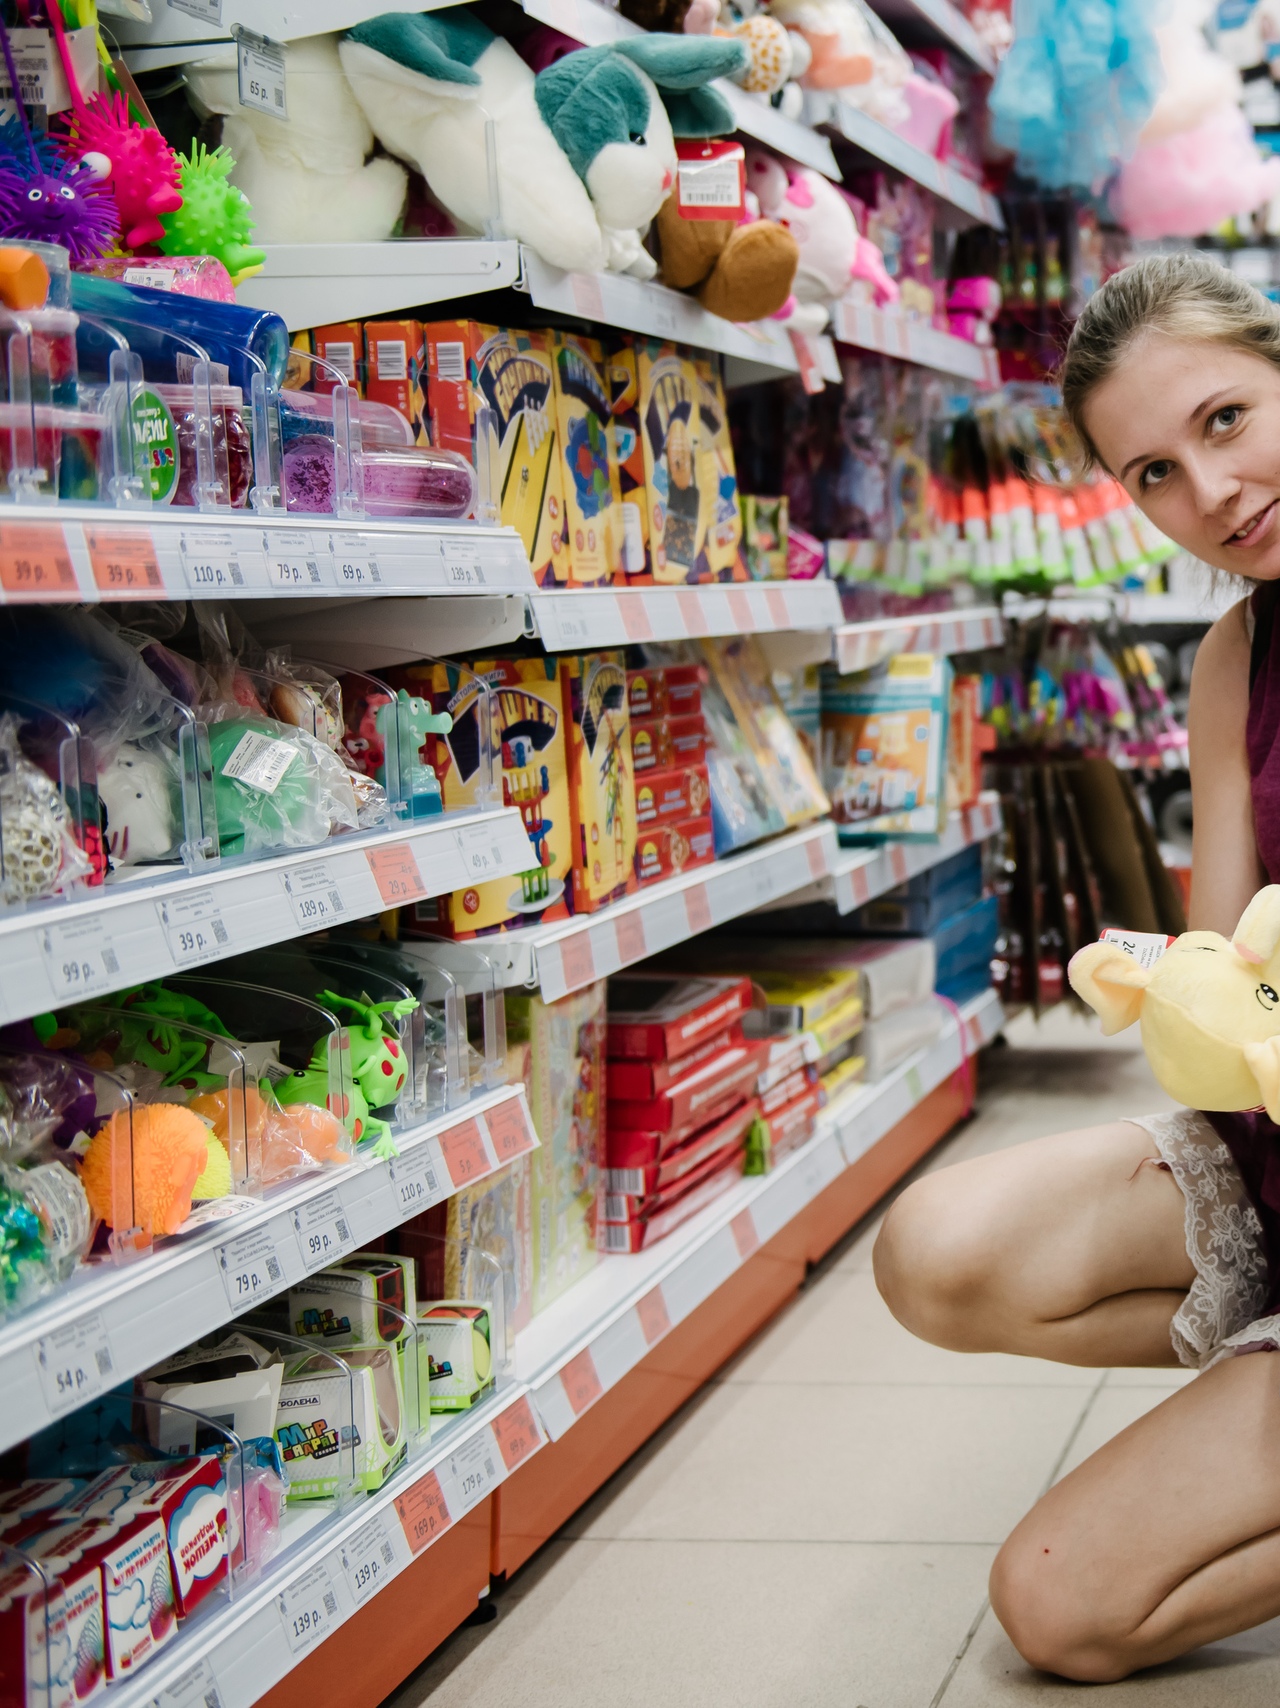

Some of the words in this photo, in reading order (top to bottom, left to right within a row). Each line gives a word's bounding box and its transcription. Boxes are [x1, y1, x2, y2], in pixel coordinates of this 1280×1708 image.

[250, 80, 259, 96] 65
[14, 559, 31, 580] 39
[107, 563, 123, 582] 39
[193, 565, 214, 582] 110
[277, 563, 291, 579] 79
[342, 564, 354, 580] 69
[450, 566, 465, 581] 139
[472, 854, 481, 868] 49
[388, 879, 400, 895] 29
[299, 899, 317, 918] 189
[179, 931, 194, 951] 39
[62, 961, 80, 983] 99
[459, 1159, 466, 1173] 5
[400, 1183, 416, 1203] 110
[308, 1234, 322, 1254] 99
[235, 1274, 250, 1294] 79
[56, 1369, 73, 1393] 54
[462, 1474, 476, 1496] 179
[413, 1516, 429, 1540] 169
[180, 1520, 215, 1558] ПОДАРКОВ
[182, 1531, 219, 1575] МЕШОК
[354, 1563, 371, 1590] 139
[292, 1612, 311, 1638] 139
